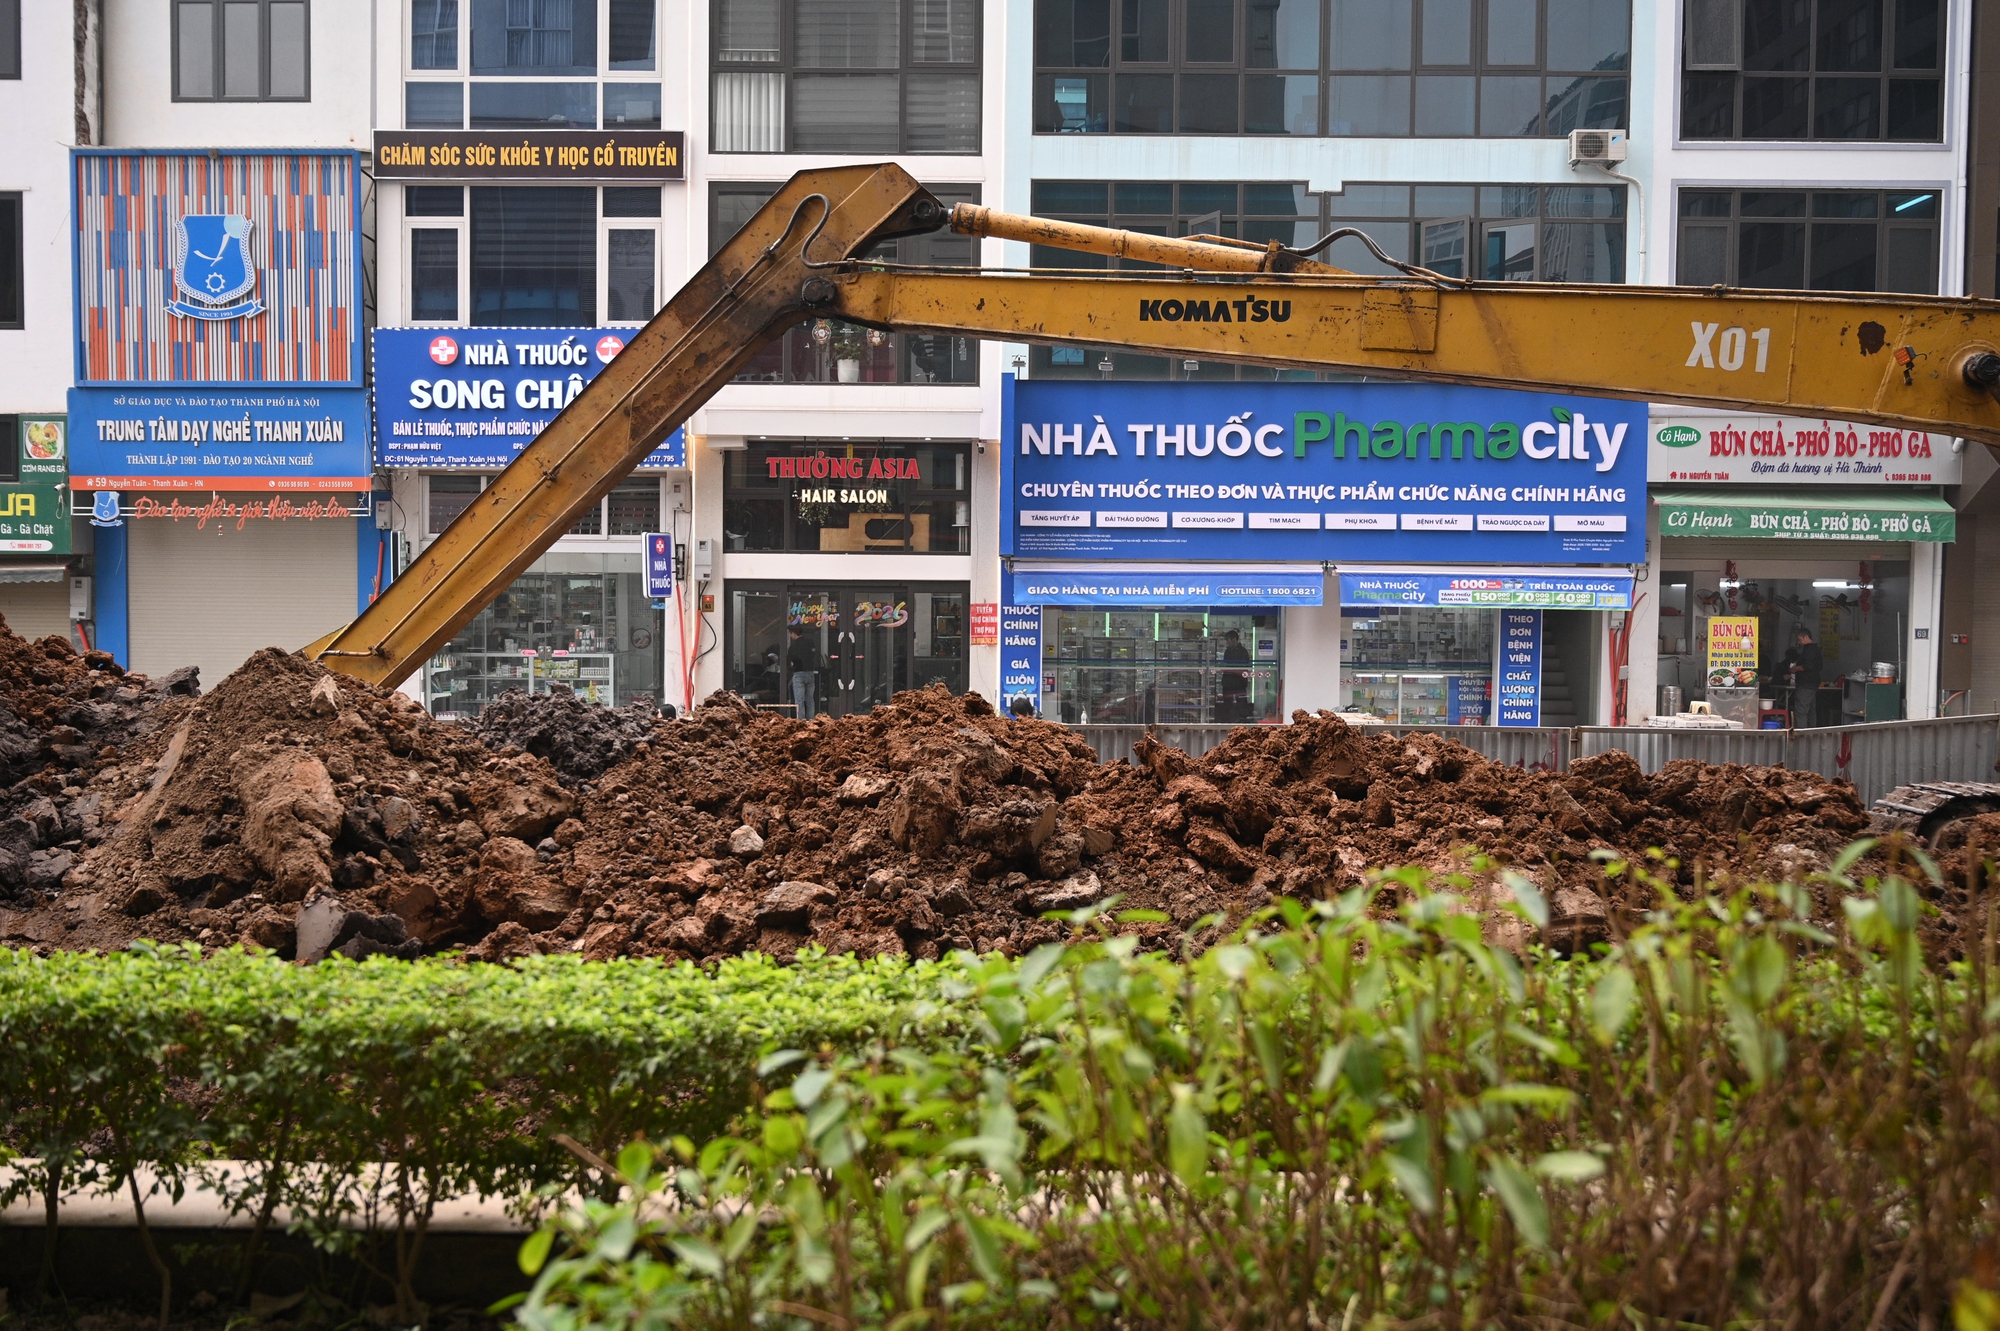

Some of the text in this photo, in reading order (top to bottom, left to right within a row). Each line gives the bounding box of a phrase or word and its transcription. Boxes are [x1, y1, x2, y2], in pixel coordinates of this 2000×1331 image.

[380, 139, 677, 170] CHĂM SÓC SỨC KHỎE Y HỌC CỔ TRUYỀN
[1139, 294, 1292, 323] KOMATSU
[465, 336, 588, 366] NHÀ THUỐC
[1686, 321, 1768, 374] X01
[409, 373, 592, 410] SONG CHÂ
[114, 395, 320, 408] SỞ GIÁO DỤC VÀ ĐÀO TẠO THÀNH PHỐ HÀ NỘI
[97, 412, 342, 446] TRUNG TÂM DẠY NGHỀ THANH XUÂN
[393, 416, 530, 438] BÁN LẺ THUỐC, THỰC PHẨM CHỨC
[1021, 408, 1629, 472] NHÀ THUỐC Pharmacity
[1660, 430, 1698, 444] Cô Hạnh
[1710, 424, 1746, 456] BÚN
[126, 453, 314, 466] THÀNH LẬP 1991 ĐÀO TẠO 20 NGÀNH NGHỀ
[766, 450, 921, 480] THƯỞNG ASIA
[1751, 461, 1882, 475] Đậm đà hương vị Hà Thành
[96, 478, 106, 487] 59
[109, 478, 130, 488] Nguyễn
[801, 489, 888, 504] HAIR SALON
[1021, 478, 1626, 504] CHUYÊN THUỐC THEO ĐƠN VÀ THỰC PHẨM CHỨC NĂNG CHÍNH HÃNG
[134, 495, 350, 531] Đào tạo nghề giới thiệu việc làm
[1050, 514, 1070, 522] HUYẾT
[1668, 510, 1932, 533] Cô Hạnh BÚN CHẢ PHỞ BÒ PHỞ GÀ
[20, 524, 54, 536] Gà Chặt
[651, 558, 670, 588] NHÀ THUỐC
[1027, 582, 1209, 597] GIAO HÀNG TẠI NHÀ MIỄN PHÍ
[1221, 587, 1316, 596] HOTLINE: 1800 6821
[1360, 580, 1419, 590] NHÀ THUỐC
[1556, 582, 1583, 590] TOÀN
[1586, 582, 1615, 591] QUỐC
[1353, 590, 1426, 602] Pharmacity
[788, 602, 840, 627] Happy New Year
[854, 601, 908, 628] 2026
[1003, 604, 1039, 615] THUỐC
[1004, 619, 1038, 630] CHÍNH
[1508, 615, 1534, 624] THEO
[1510, 627, 1532, 637] ĐƠN
[1712, 619, 1754, 637] BÚN CHẢ
[1005, 635, 1036, 646] HÃNG
[1508, 639, 1533, 651] BỆNH
[1011, 658, 1030, 669] GIÁ
[1509, 653, 1531, 664] VIỆN
[1006, 674, 1035, 685] LUÔN
[1506, 670, 1532, 680] CHẤT
[1502, 685, 1535, 695] LƯỢNG
[1503, 696, 1533, 707] CHÍNH
[1504, 710, 1532, 720] HÃNG
